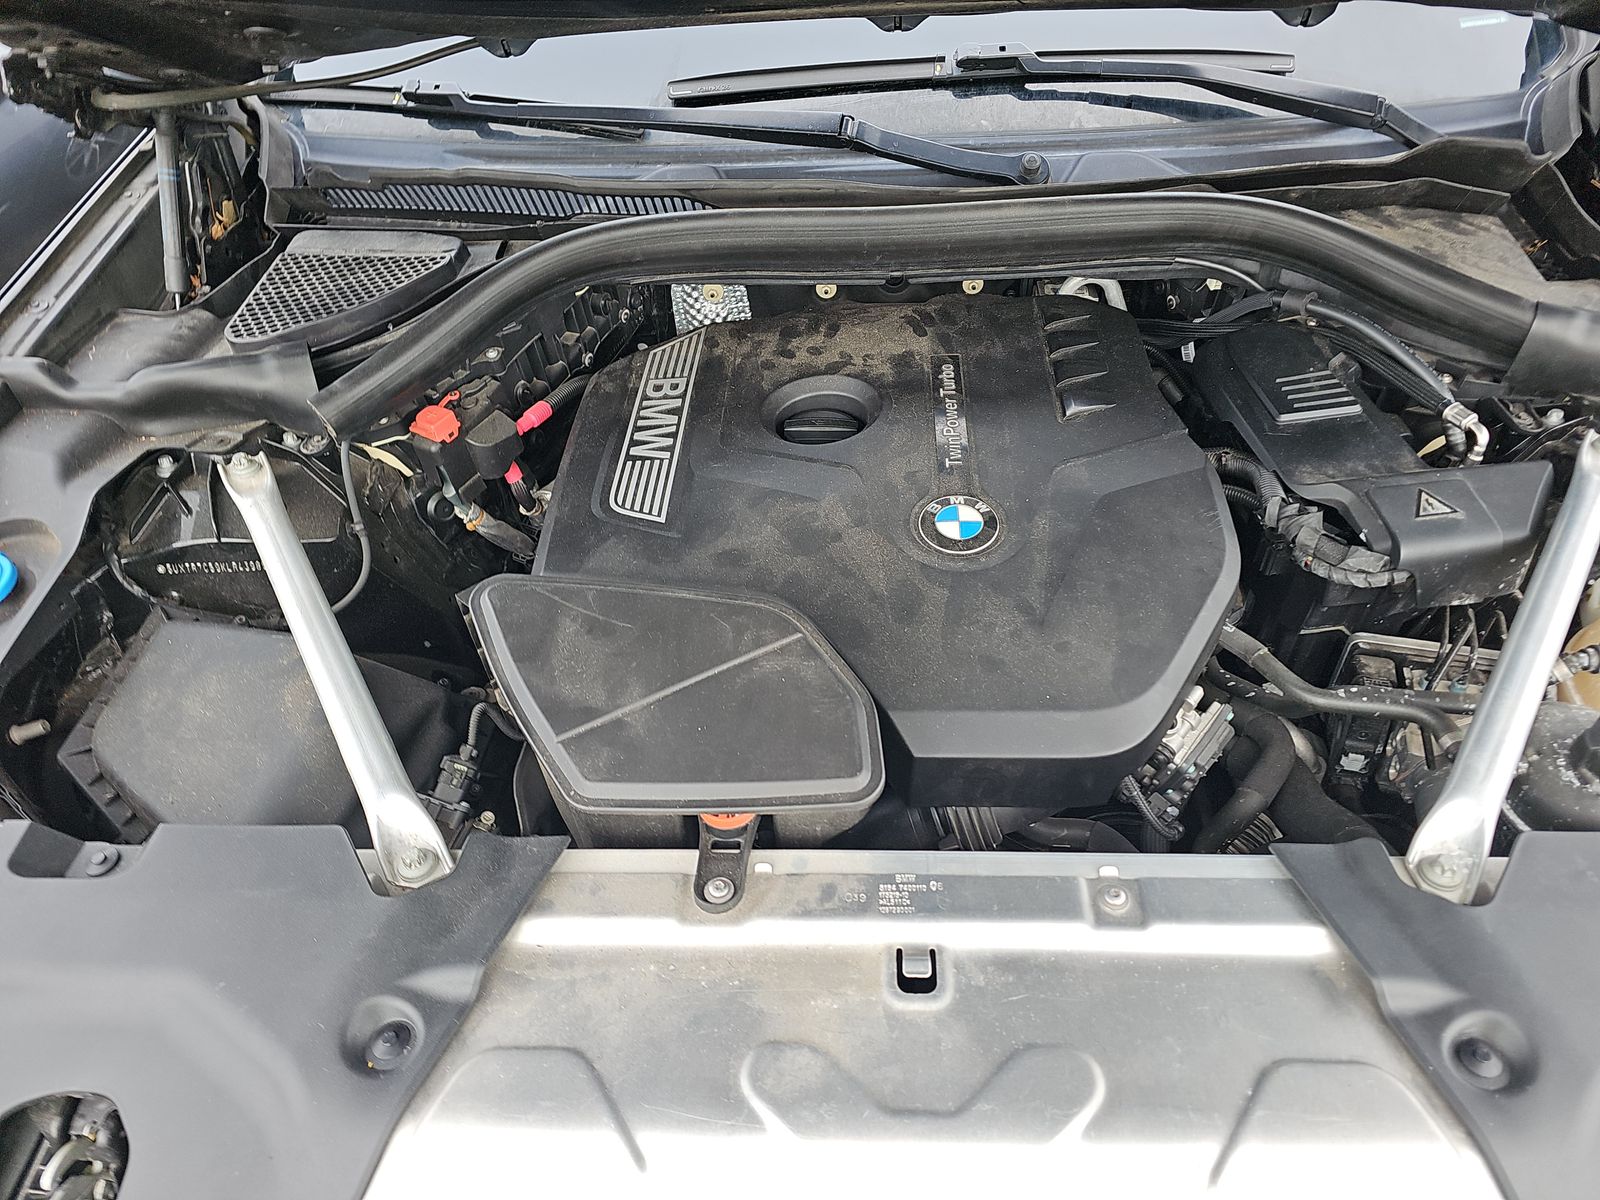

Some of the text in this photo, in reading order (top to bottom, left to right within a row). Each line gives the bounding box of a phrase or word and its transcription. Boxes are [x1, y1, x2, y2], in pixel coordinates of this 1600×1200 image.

[629, 377, 687, 459] BMW
[939, 363, 963, 468] TwinPower Turbo
[927, 496, 990, 514] BMW
[895, 873, 917, 883] BMW
